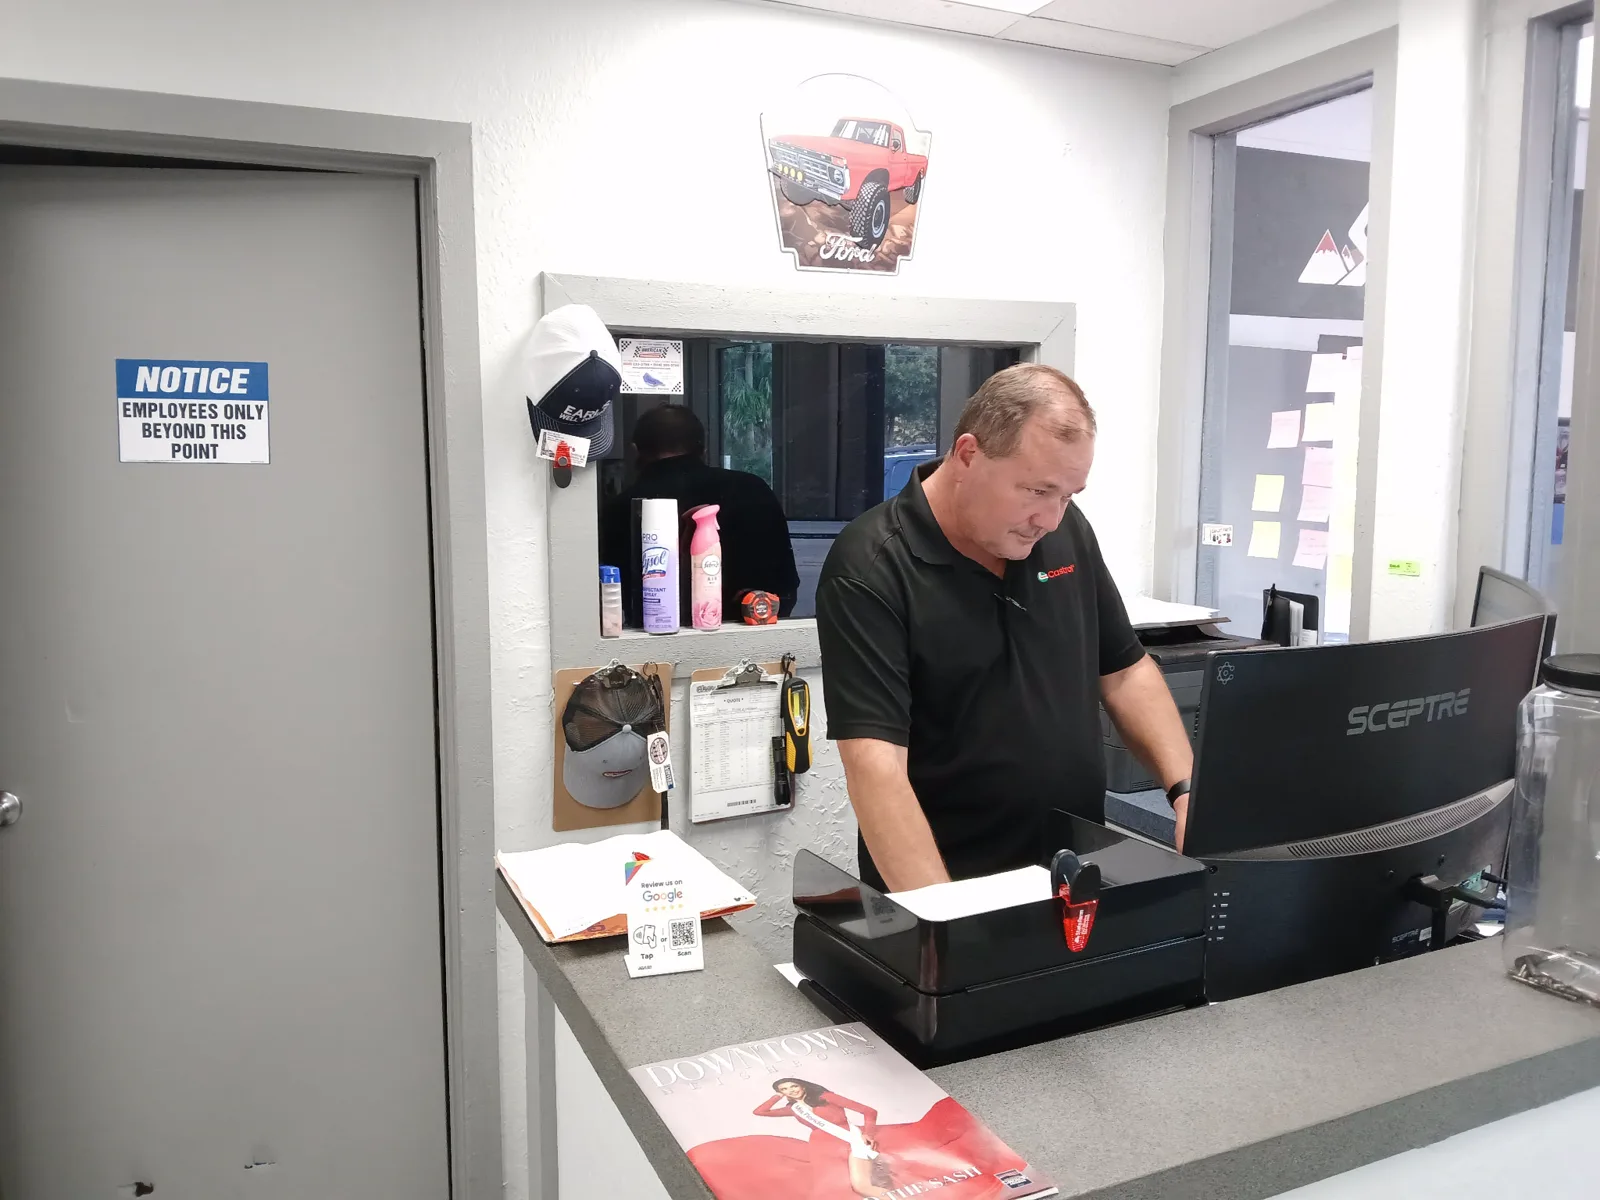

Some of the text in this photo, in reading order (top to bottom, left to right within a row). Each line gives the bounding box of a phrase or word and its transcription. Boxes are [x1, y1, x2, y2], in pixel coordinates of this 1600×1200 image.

[819, 233, 878, 263] Ford
[135, 366, 250, 394] NOTICE
[122, 402, 265, 421] EMPLOYEES ONLY
[559, 412, 578, 423] WELL
[141, 422, 247, 440] BEYOND THIS
[171, 443, 219, 459] POINT
[1346, 688, 1471, 736] SCEPTRE
[641, 881, 664, 889] Review
[642, 887, 683, 903] Google
[645, 1026, 870, 1088] DOWNTOWN
[928, 1165, 983, 1188] SASH
